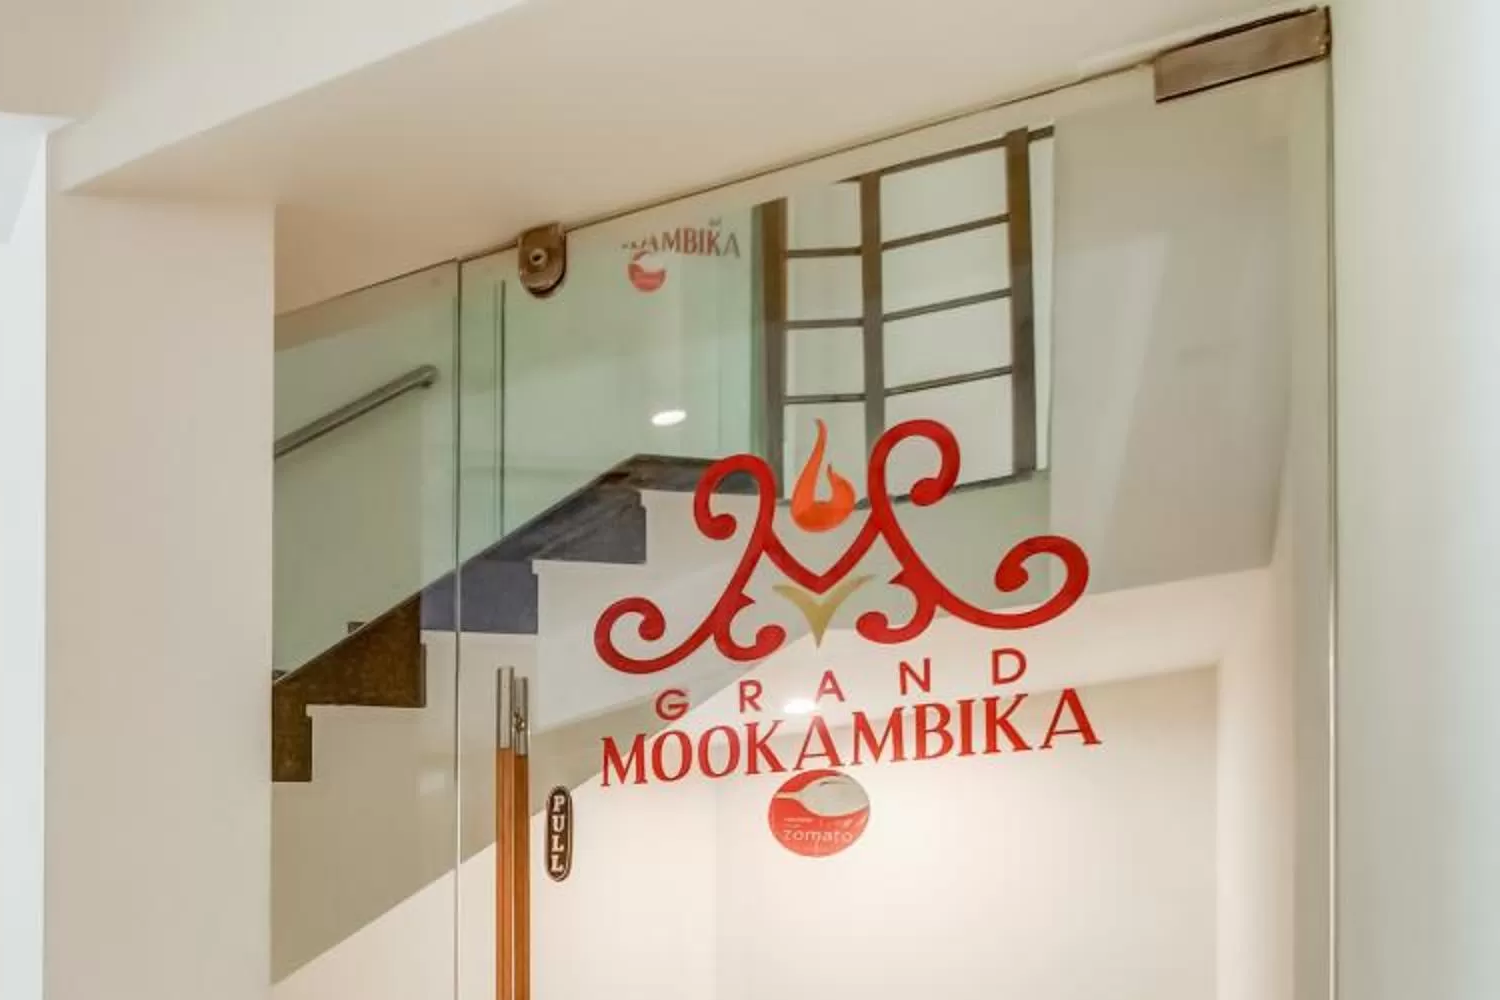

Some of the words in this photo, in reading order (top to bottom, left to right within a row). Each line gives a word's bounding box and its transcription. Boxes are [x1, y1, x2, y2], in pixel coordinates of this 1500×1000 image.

[655, 647, 1028, 721] GRAND
[601, 687, 1102, 787] MOOKAMBIKA
[551, 795, 565, 873] PULL
[783, 829, 854, 843] zomato
